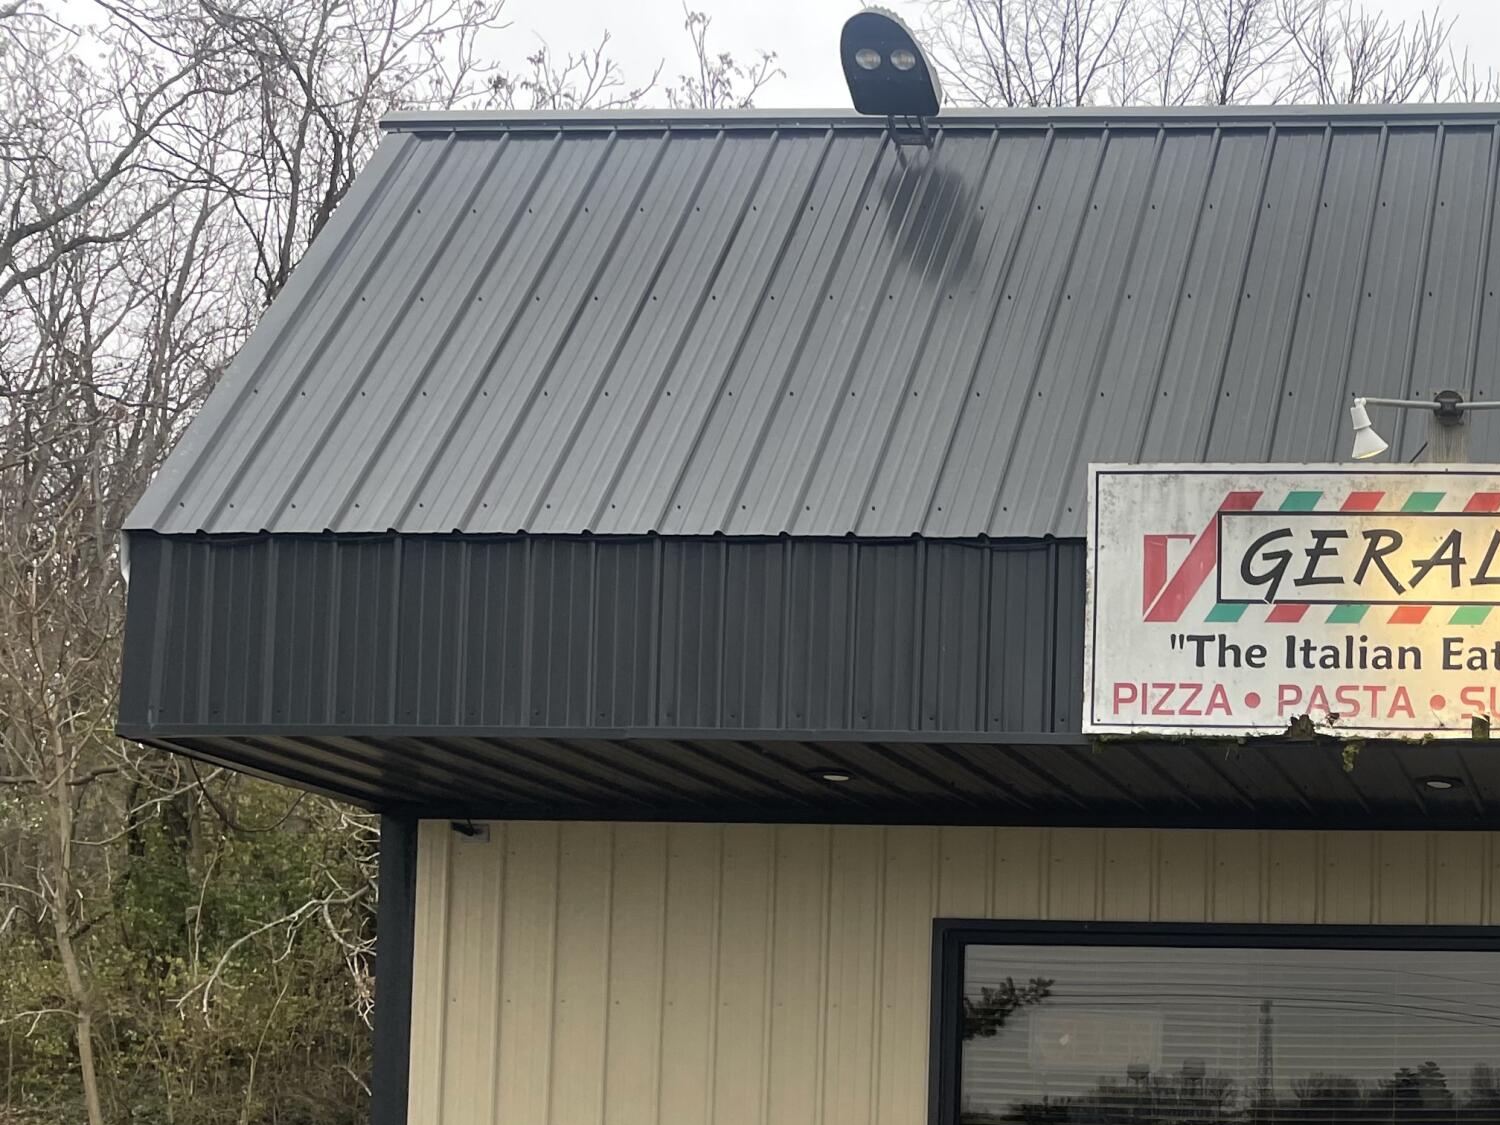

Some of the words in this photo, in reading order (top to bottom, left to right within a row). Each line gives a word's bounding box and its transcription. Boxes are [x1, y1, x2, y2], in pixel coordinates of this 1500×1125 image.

[1170, 634, 1267, 669] "The
[1286, 634, 1422, 670] Italian
[1113, 682, 1232, 716] PIZZA
[1278, 684, 1415, 719] PASTA
